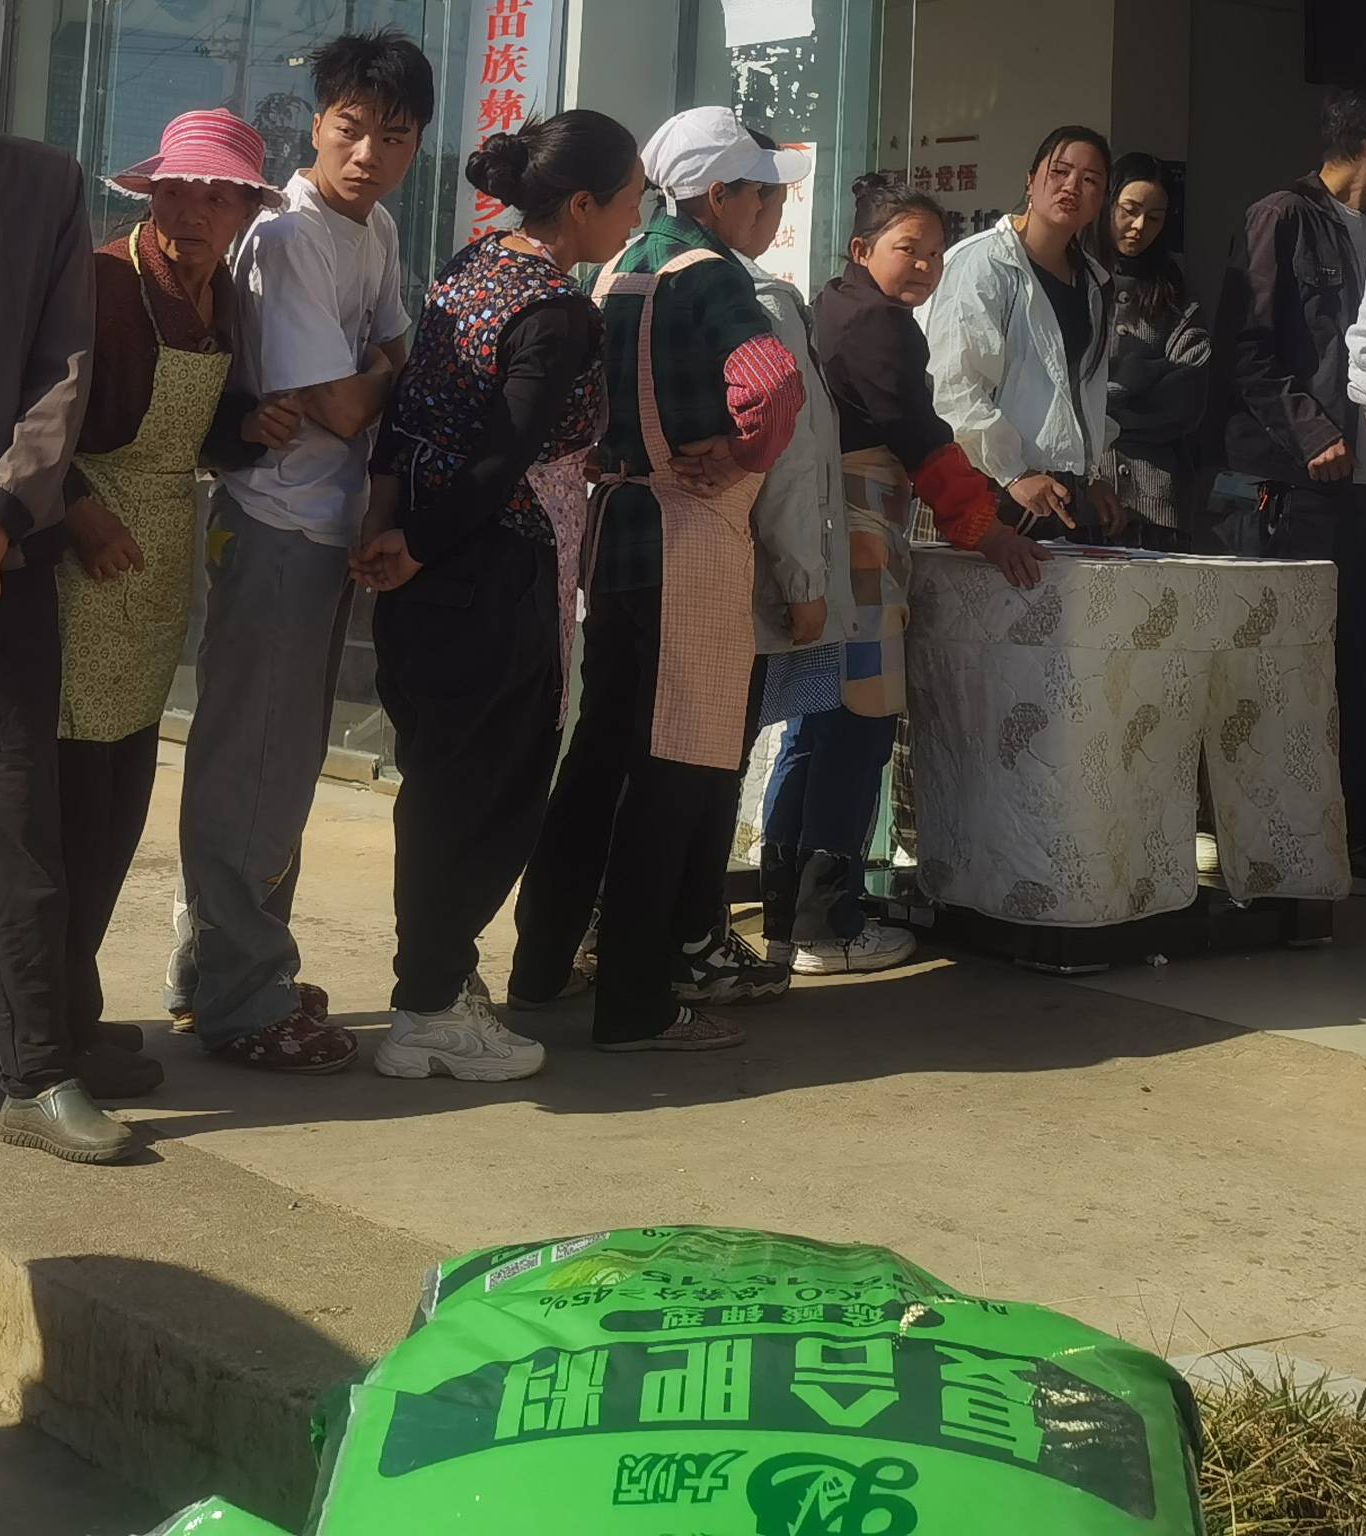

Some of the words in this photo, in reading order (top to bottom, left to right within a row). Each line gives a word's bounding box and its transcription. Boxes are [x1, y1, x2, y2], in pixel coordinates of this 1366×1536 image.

[661, 1303, 885, 1330] 硫酸钾型
[494, 1336, 1044, 1463] 复合肥料
[611, 1449, 747, 1505] 大顺
